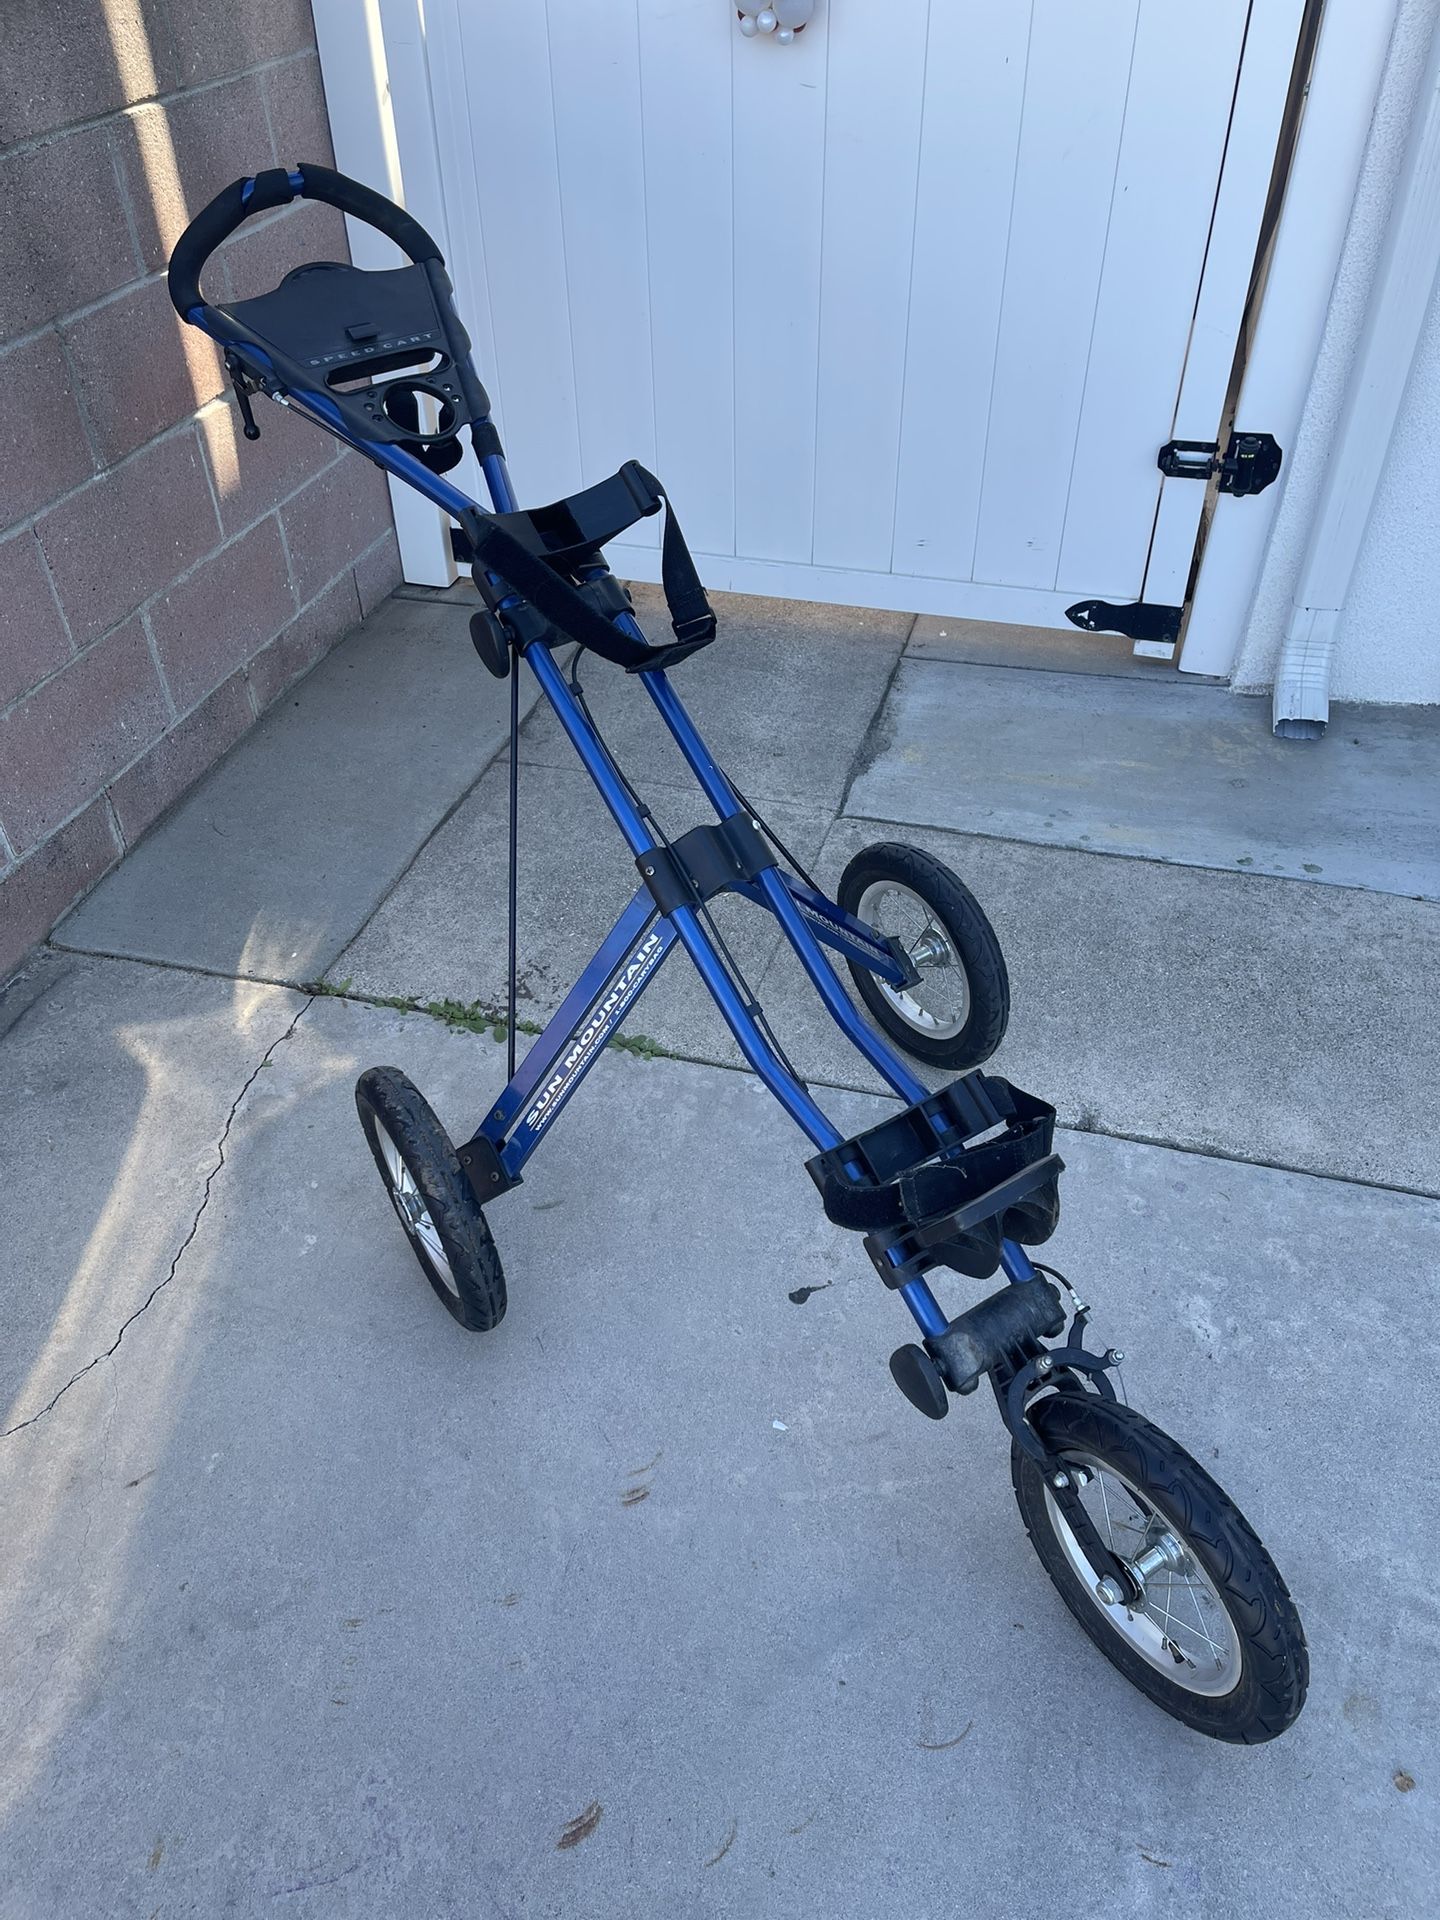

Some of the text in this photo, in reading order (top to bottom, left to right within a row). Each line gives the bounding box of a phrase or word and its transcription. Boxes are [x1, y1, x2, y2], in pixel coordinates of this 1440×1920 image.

[310, 333, 432, 365] SPEED CART
[526, 933, 659, 1127] SUN MOUNTAIN
